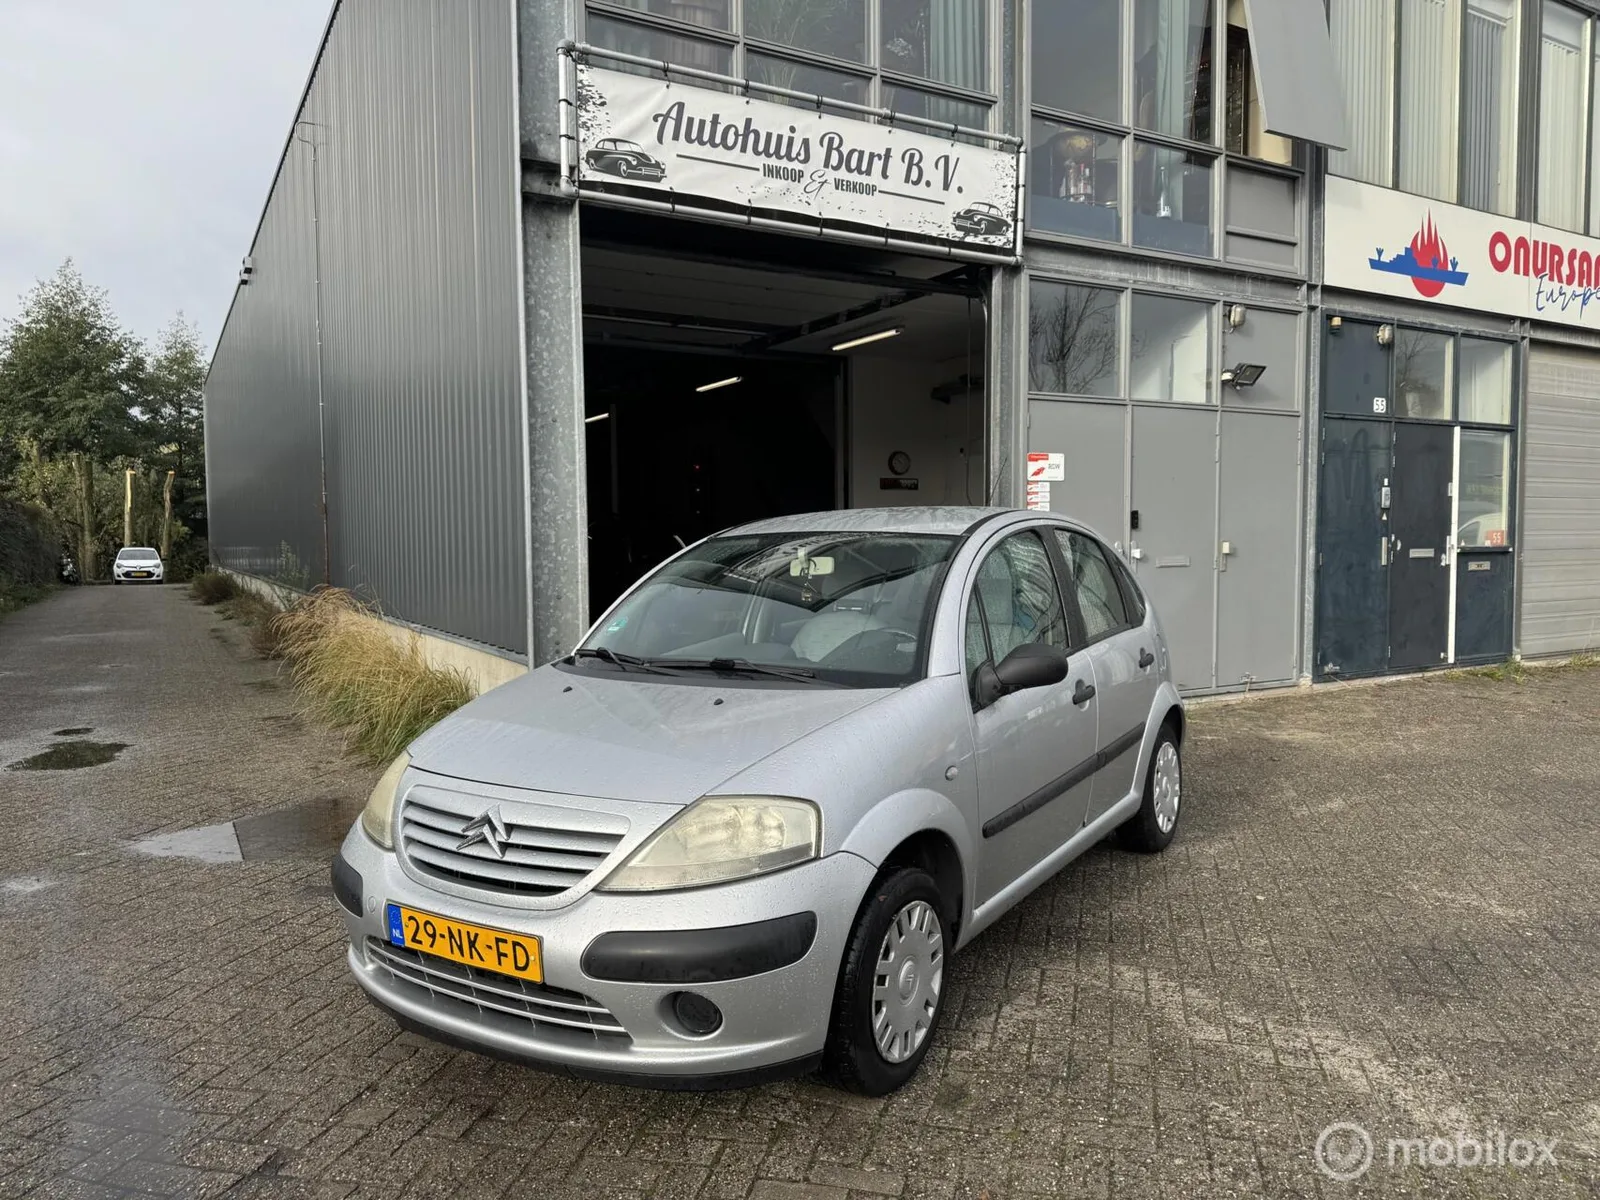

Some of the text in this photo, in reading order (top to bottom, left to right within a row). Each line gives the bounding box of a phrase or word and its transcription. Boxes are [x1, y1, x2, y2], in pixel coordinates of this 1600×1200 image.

[652, 101, 964, 194] Autohuis Bart B.V.
[762, 163, 804, 183] INKOOP
[834, 177, 877, 196] VERKOOP
[392, 928, 404, 939] NL
[407, 915, 530, 972] 29-NK-FD
